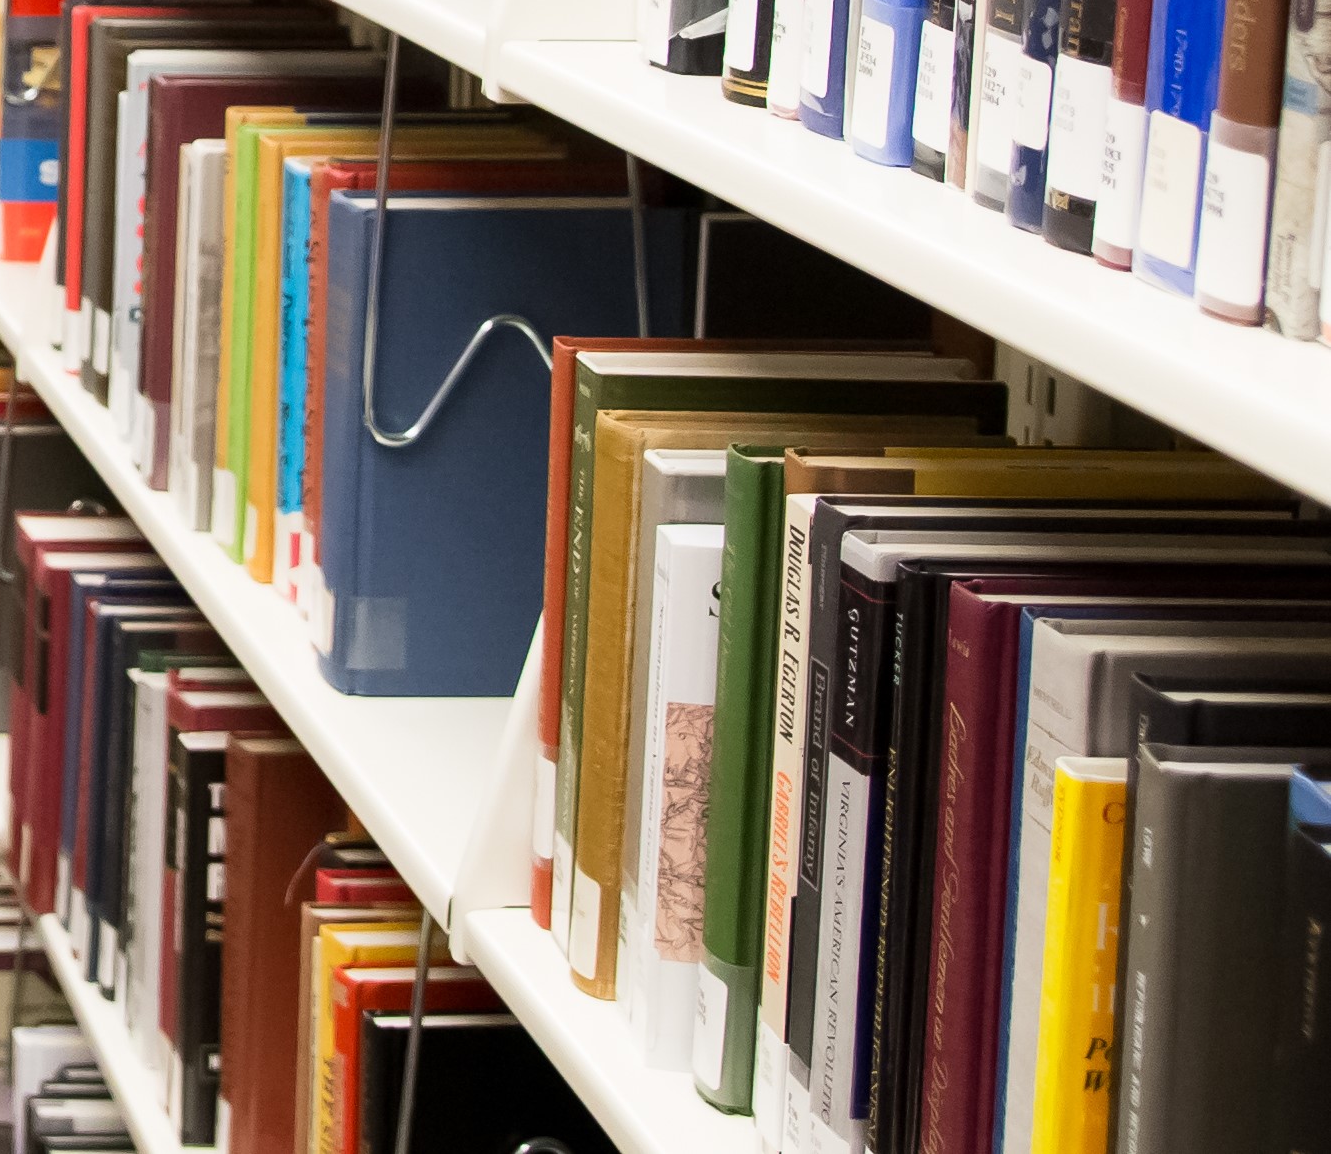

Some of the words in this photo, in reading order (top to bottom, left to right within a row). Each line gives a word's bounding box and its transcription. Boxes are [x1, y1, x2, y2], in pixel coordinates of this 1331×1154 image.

[784, 524, 806, 621] DOUGLAS
[778, 649, 800, 745] EGERTON
[845, 607, 861, 729] GUTZMAN
[892, 611, 904, 687] TUCKER
[811, 671, 827, 750] Brand
[943, 700, 967, 804] Ladies
[771, 769, 794, 873] GABRIEL'S
[809, 756, 821, 783] of
[803, 786, 822, 879] Infamy
[833, 779, 852, 887] VIRGINIA'S
[879, 746, 897, 930] ENLIGHTENED
[765, 875, 789, 986] REBELLION
[828, 893, 845, 1003] AMERICAN
[934, 864, 962, 1015] Gentlemen
[821, 1006, 838, 1127] REVOLUTIO
